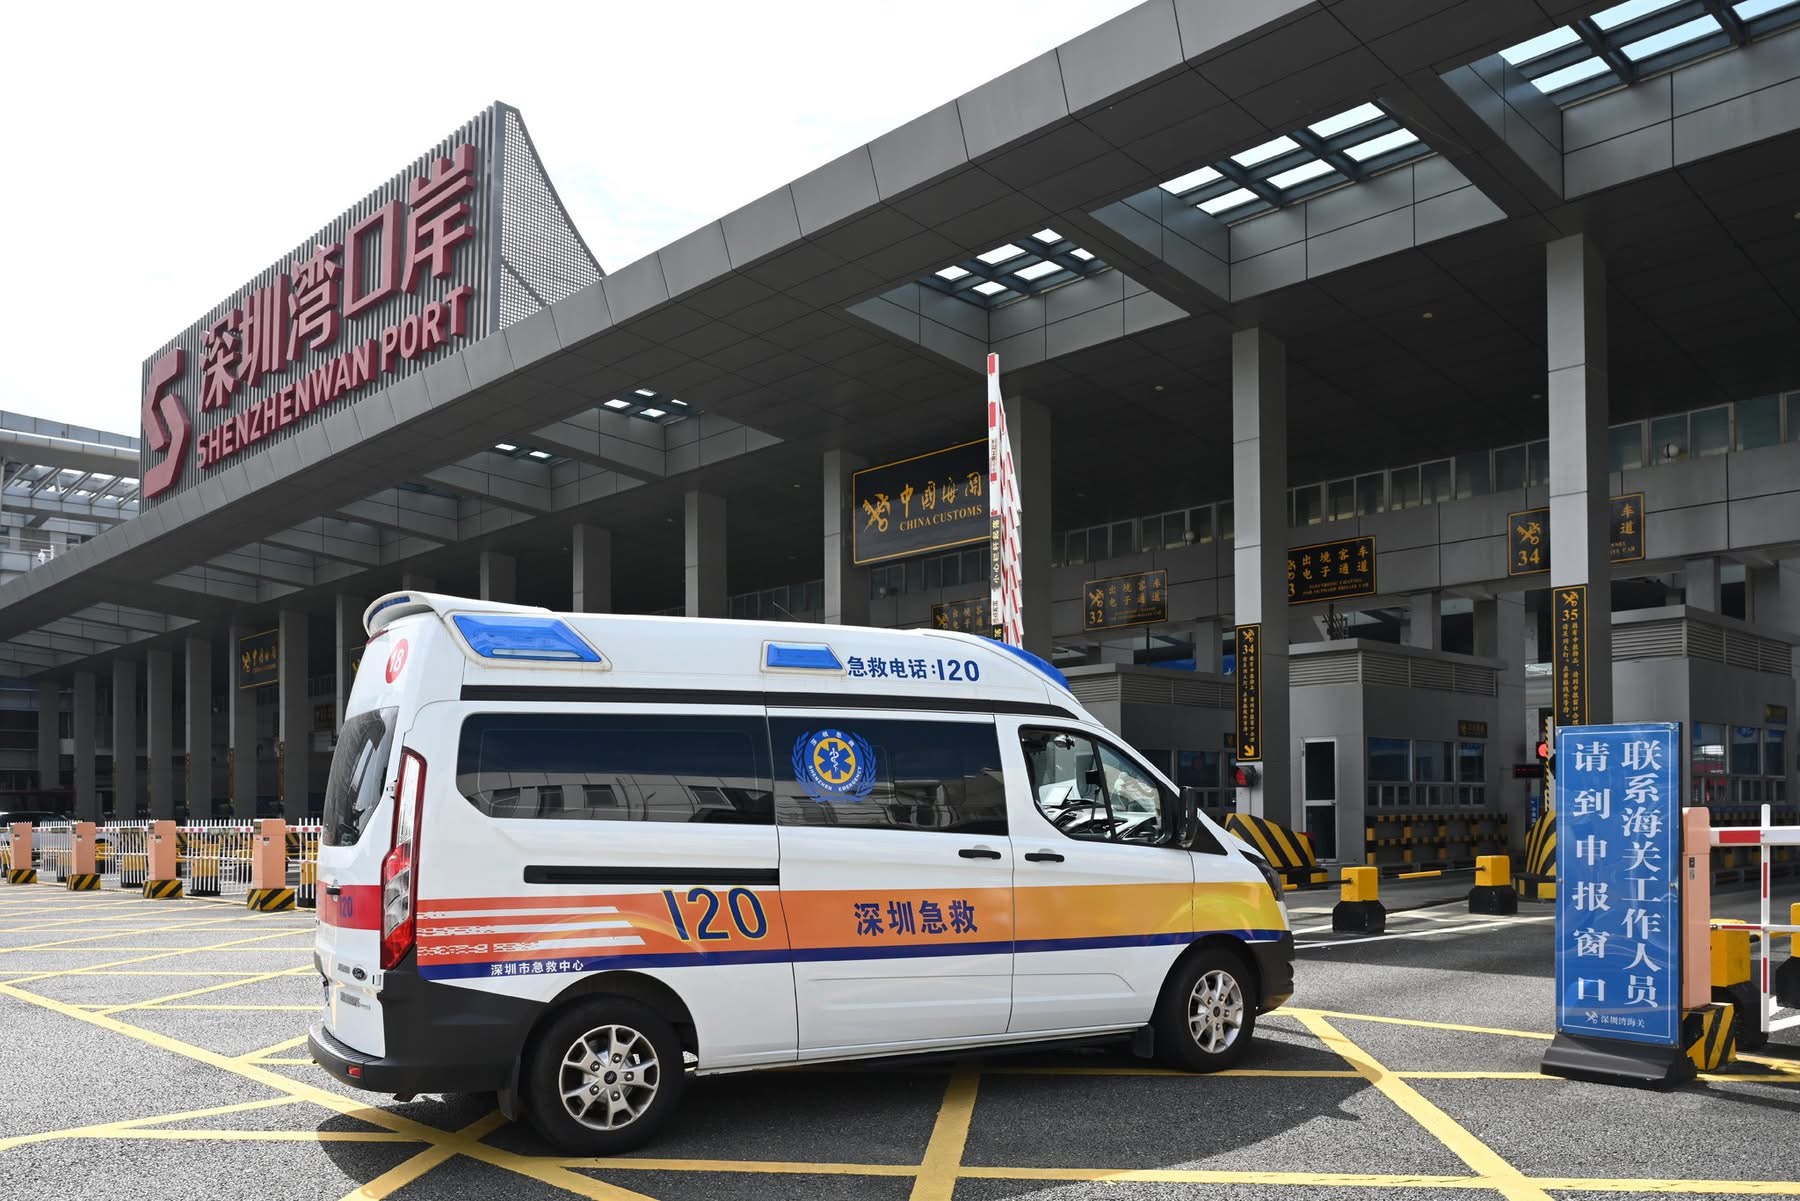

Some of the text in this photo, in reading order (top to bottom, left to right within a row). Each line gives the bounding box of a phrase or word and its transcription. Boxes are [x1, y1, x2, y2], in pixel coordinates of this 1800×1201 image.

[200, 143, 475, 412] 深圳湾口岸
[195, 284, 473, 469] SHENZHENWAN PORT
[899, 504, 983, 532] CHINA CUSTOMS
[1518, 547, 1541, 567] 34
[1088, 610, 1104, 624] 32
[1562, 609, 1579, 621] 35
[390, 648, 405, 673] 18
[1242, 644, 1255, 655] 34
[808, 765, 862, 792] SHENZHEN EMERGENCY
[1571, 741, 1611, 1002] 请到申报窗口
[1620, 739, 1663, 1009] 联系海关工作人员
[661, 886, 769, 942] 120
[853, 900, 978, 936] 深圳急救
[490, 959, 584, 976] 深圳市急救中心
